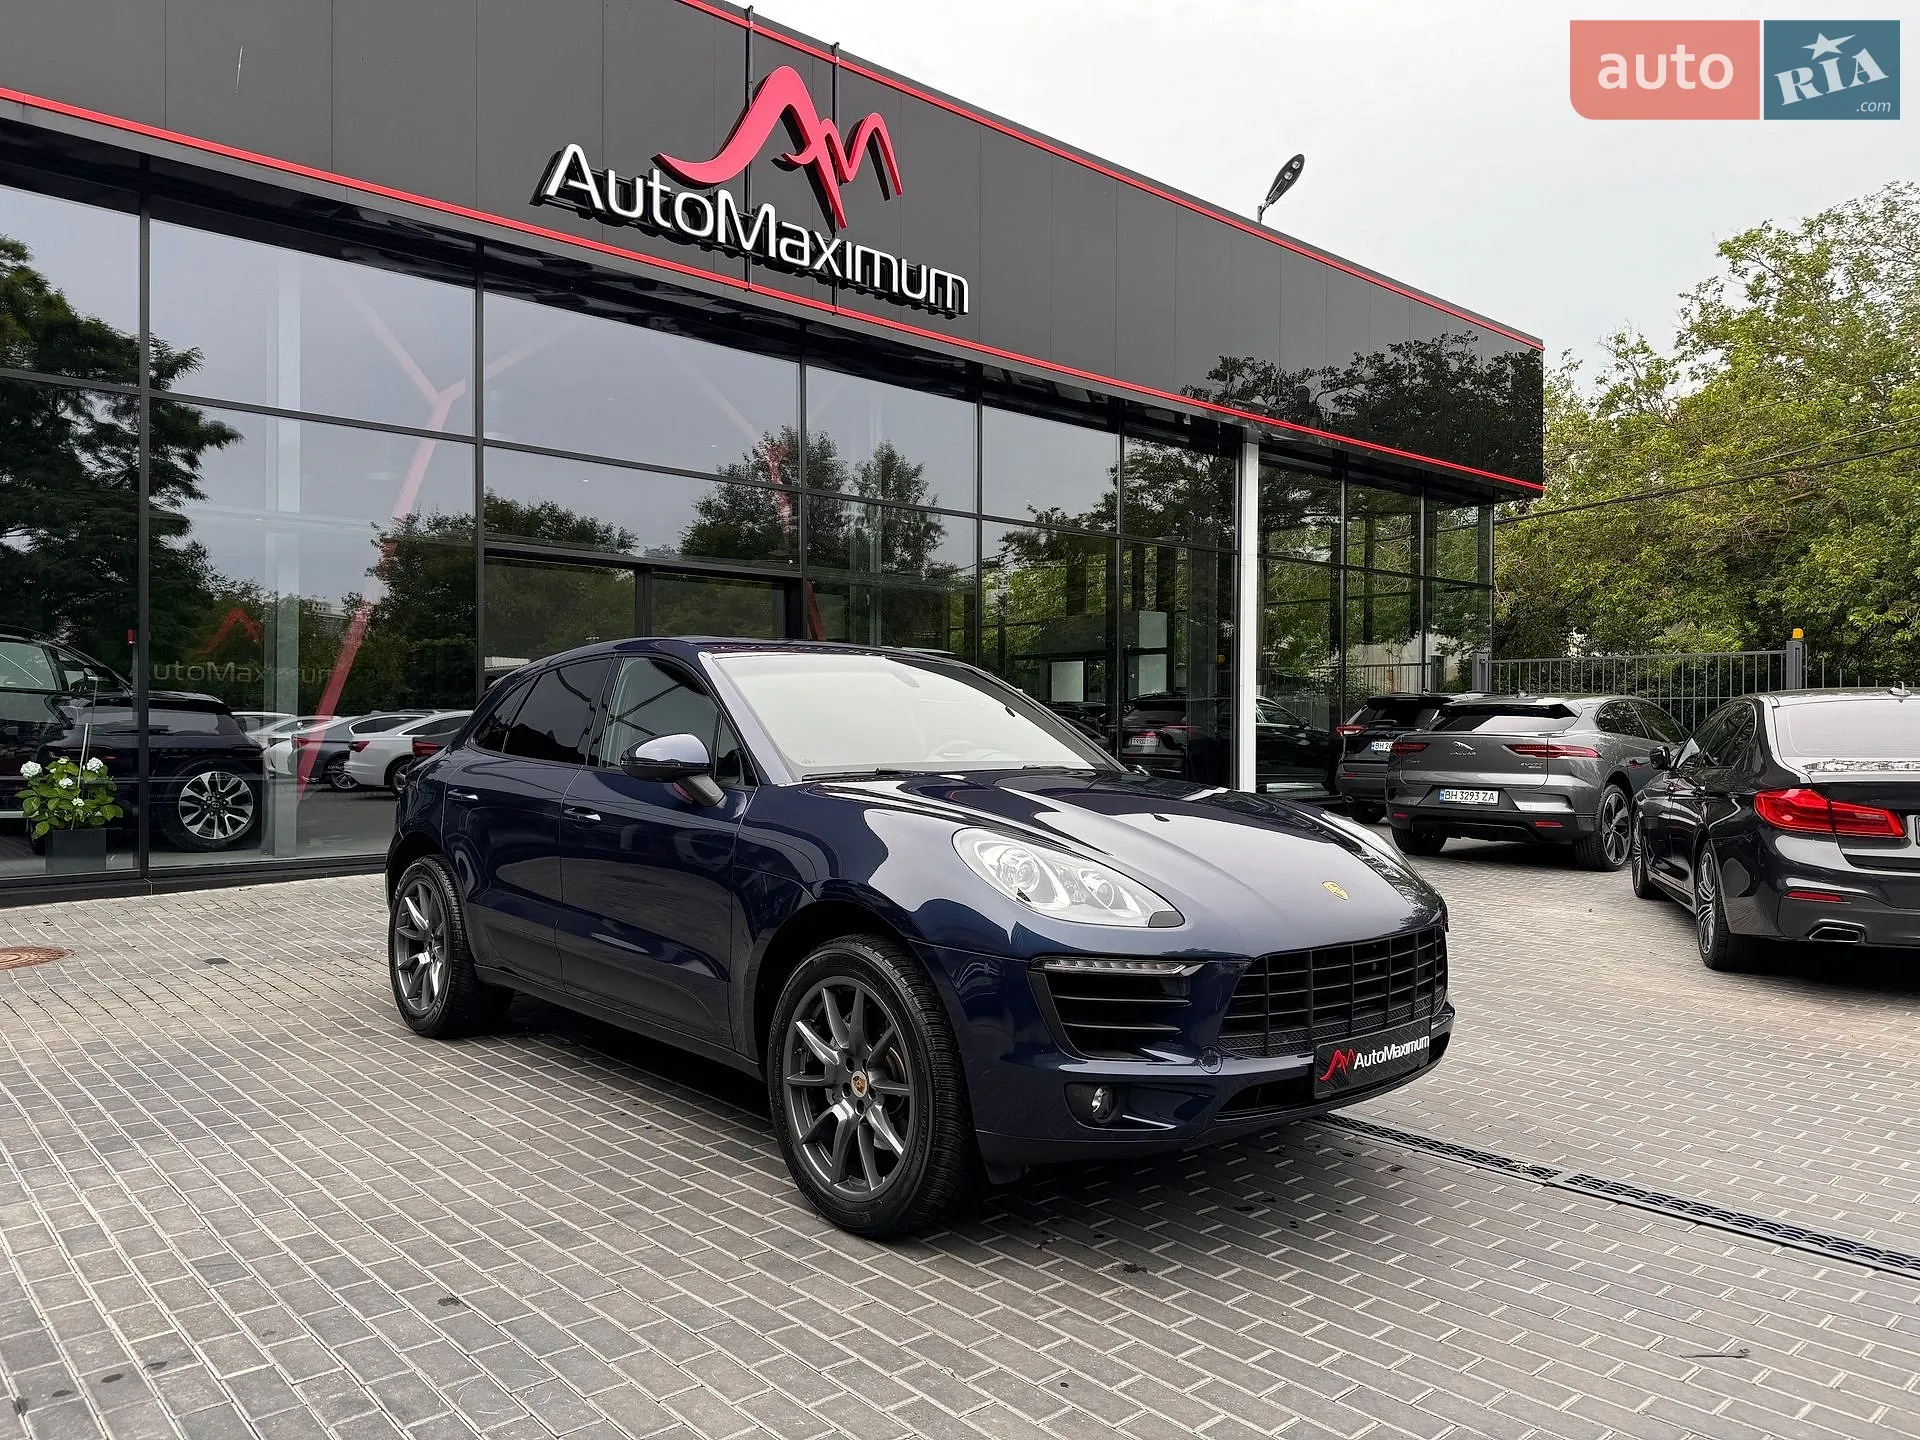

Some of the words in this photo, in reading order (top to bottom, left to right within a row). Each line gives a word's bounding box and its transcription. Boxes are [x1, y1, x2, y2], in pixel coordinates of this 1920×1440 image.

[546, 143, 969, 315] AutoMaximum
[1444, 790, 1458, 800] BH
[1459, 791, 1480, 801] 3293
[1353, 1035, 1430, 1070] AutoMaximum
